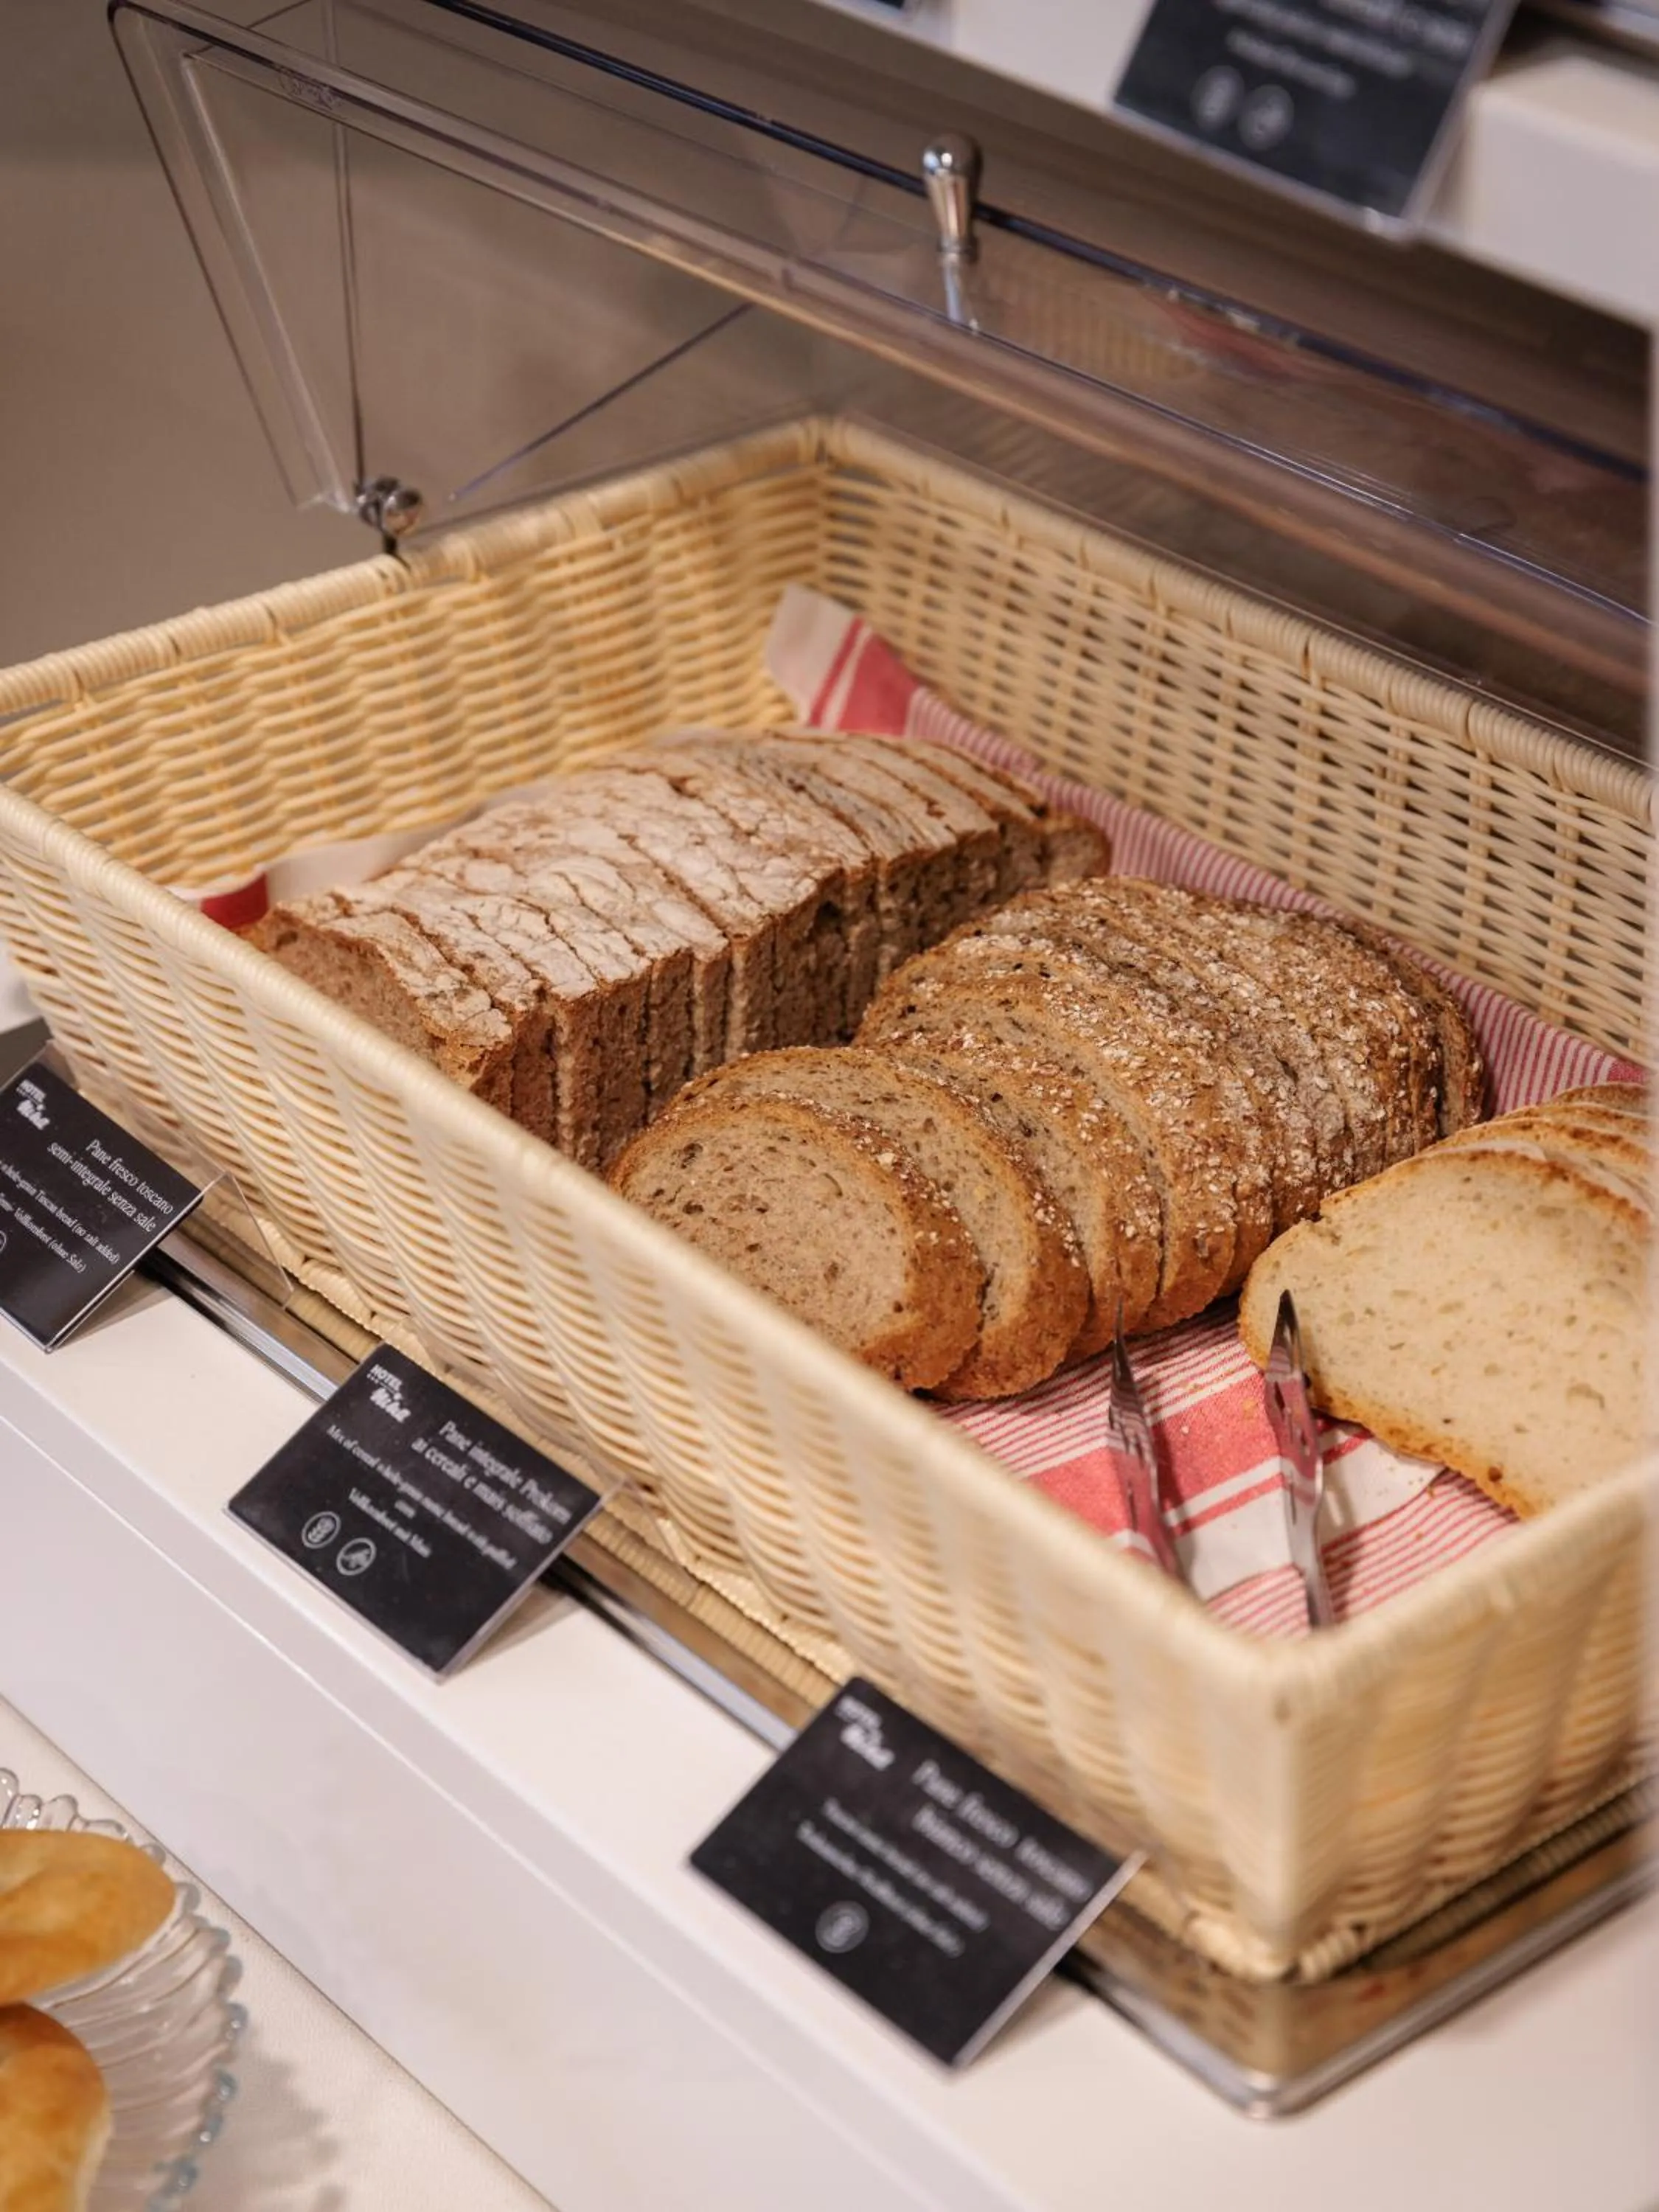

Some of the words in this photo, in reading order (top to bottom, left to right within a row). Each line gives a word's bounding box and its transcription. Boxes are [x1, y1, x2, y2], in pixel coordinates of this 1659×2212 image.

[47, 1143, 111, 1195] semi-integrale
[107, 1192, 137, 1217] senza
[133, 1213, 156, 1232] sale
[86, 1139, 111, 1164] Pane
[108, 1158, 139, 1186] fresco
[136, 1181, 173, 1214] toscano
[55, 1207, 78, 1228] bread
[72, 1223, 86, 1237] (no
[84, 1233, 100, 1248] salt
[95, 1243, 120, 1264] added)
[370, 1364, 402, 1392] HOTEL
[327, 1425, 347, 1444] Mix
[343, 1439, 359, 1450] of
[439, 1421, 472, 1451] Pane
[468, 1442, 523, 1489] integrale
[425, 1447, 467, 1481] cereali
[464, 1476, 477, 1489] e
